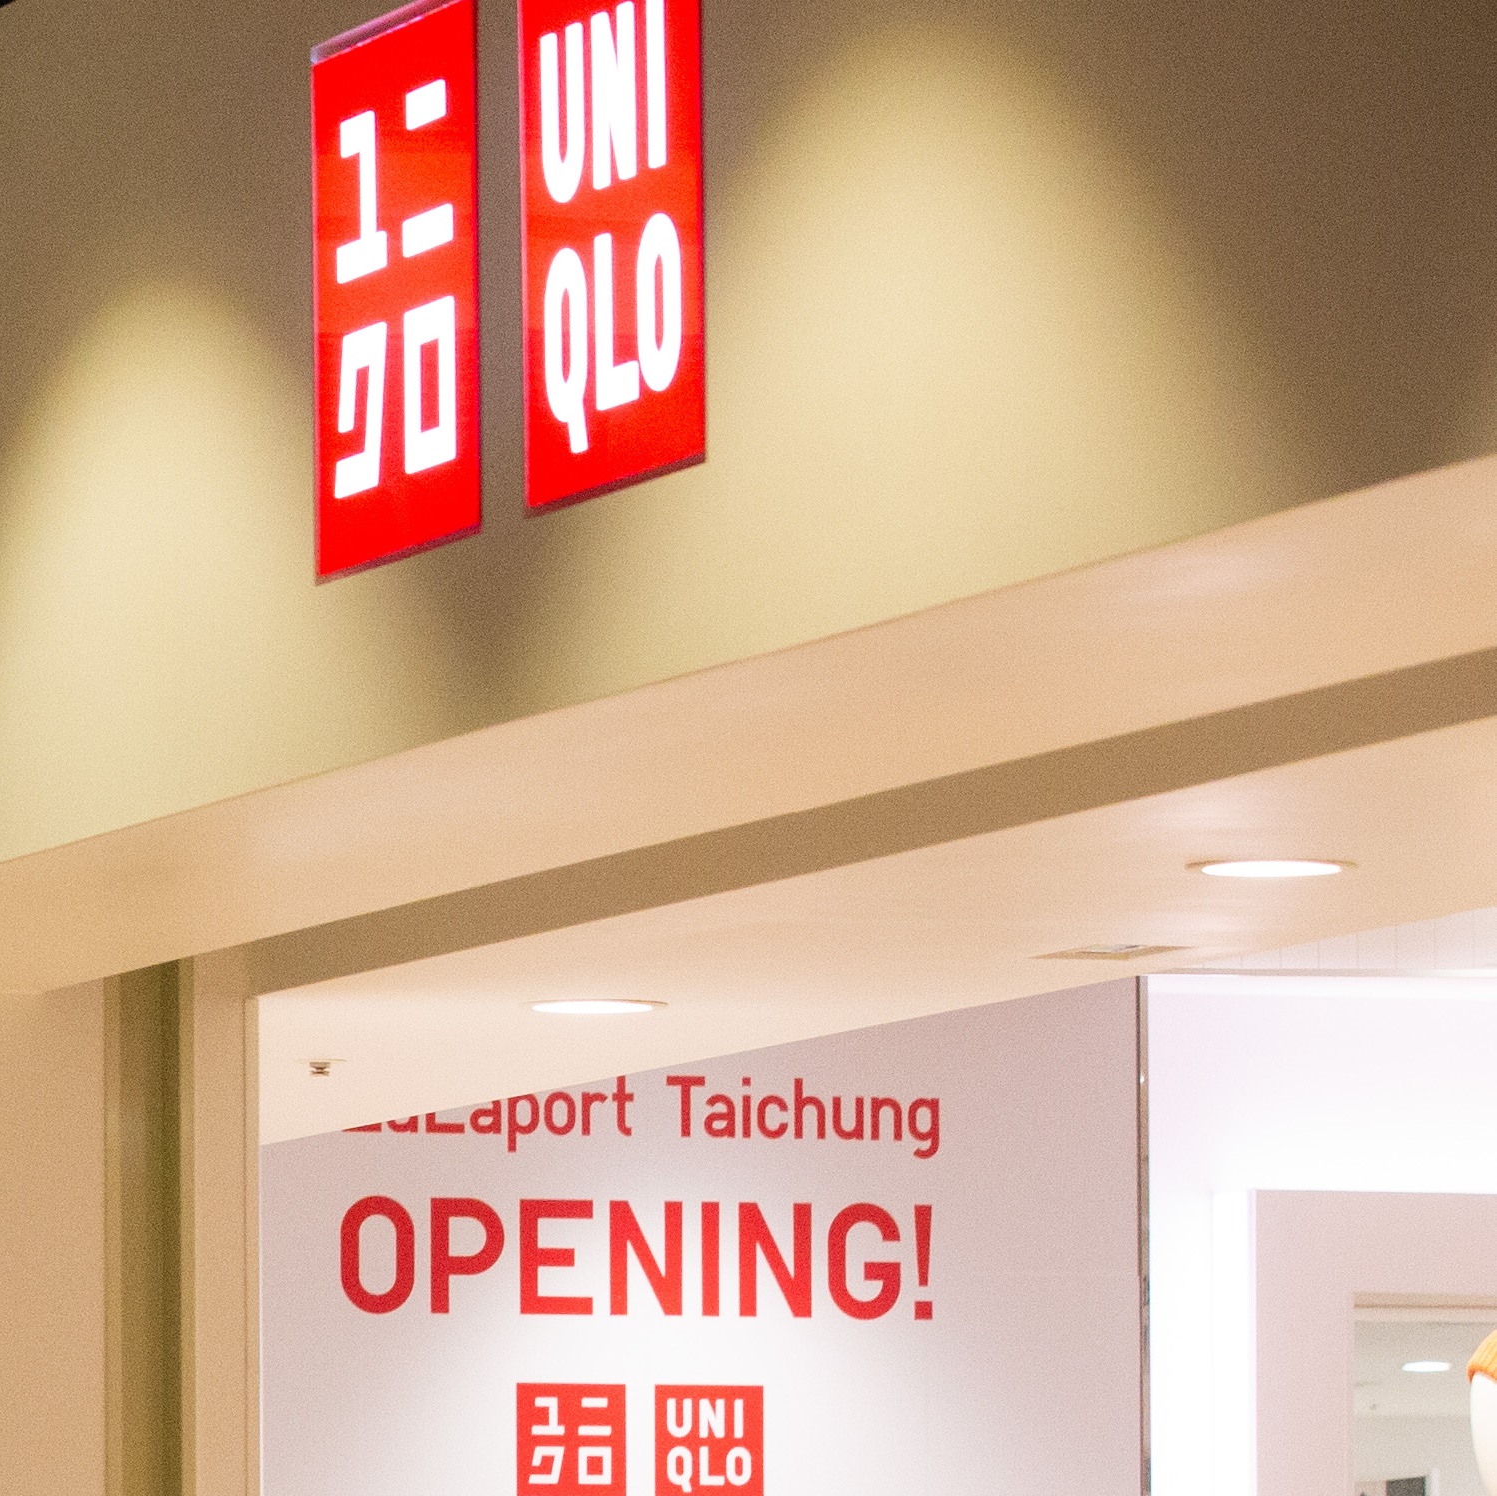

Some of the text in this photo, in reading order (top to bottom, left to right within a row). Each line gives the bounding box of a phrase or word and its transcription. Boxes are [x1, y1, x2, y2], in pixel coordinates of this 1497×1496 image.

[539, 0, 667, 203] UNI
[336, 78, 454, 284] ユニ
[543, 212, 683, 455] QLO
[334, 295, 457, 499] クロ
[344, 1075, 942, 1160] aport Taichung
[339, 1194, 934, 1321] OPENING!
[527, 1445, 613, 1486] クロ
[530, 1396, 613, 1437] ユニ
[665, 1397, 746, 1439] UNI
[665, 1446, 753, 1493] QLO
